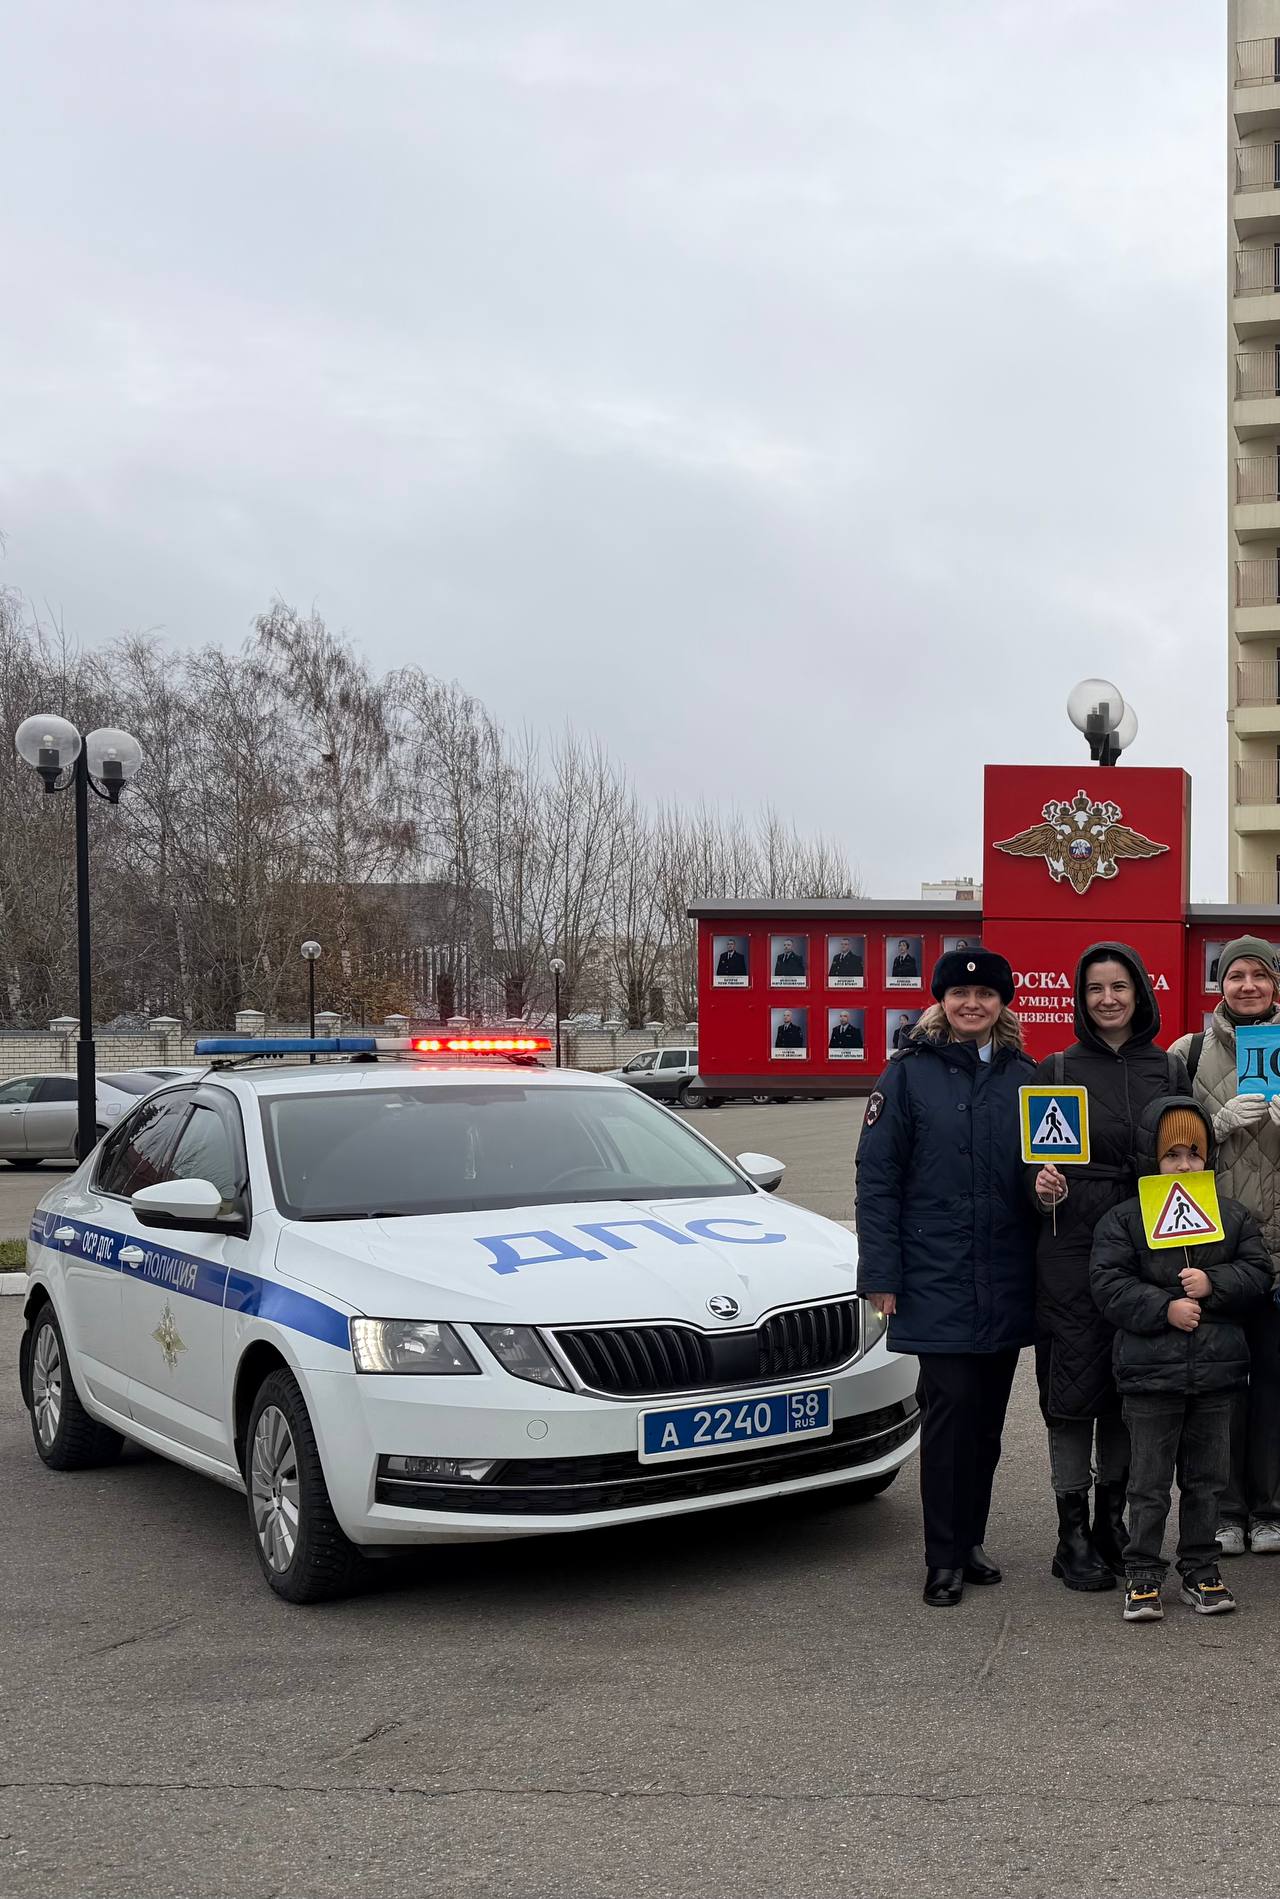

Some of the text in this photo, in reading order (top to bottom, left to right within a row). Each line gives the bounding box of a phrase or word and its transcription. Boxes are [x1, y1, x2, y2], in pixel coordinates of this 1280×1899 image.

[1012, 971, 1071, 989] ОСКА
[1019, 996, 1062, 1012] УМВД
[1016, 1011, 1079, 1027] НЗЕНСК
[82, 1230, 114, 1262] ОСР ДПС
[473, 1218, 787, 1276] ДПС
[143, 1250, 199, 1291] ПОЛИЦИЯ
[791, 1393, 820, 1419] 58
[660, 1402, 772, 1448] А 2240
[794, 1417, 816, 1429] RUS
